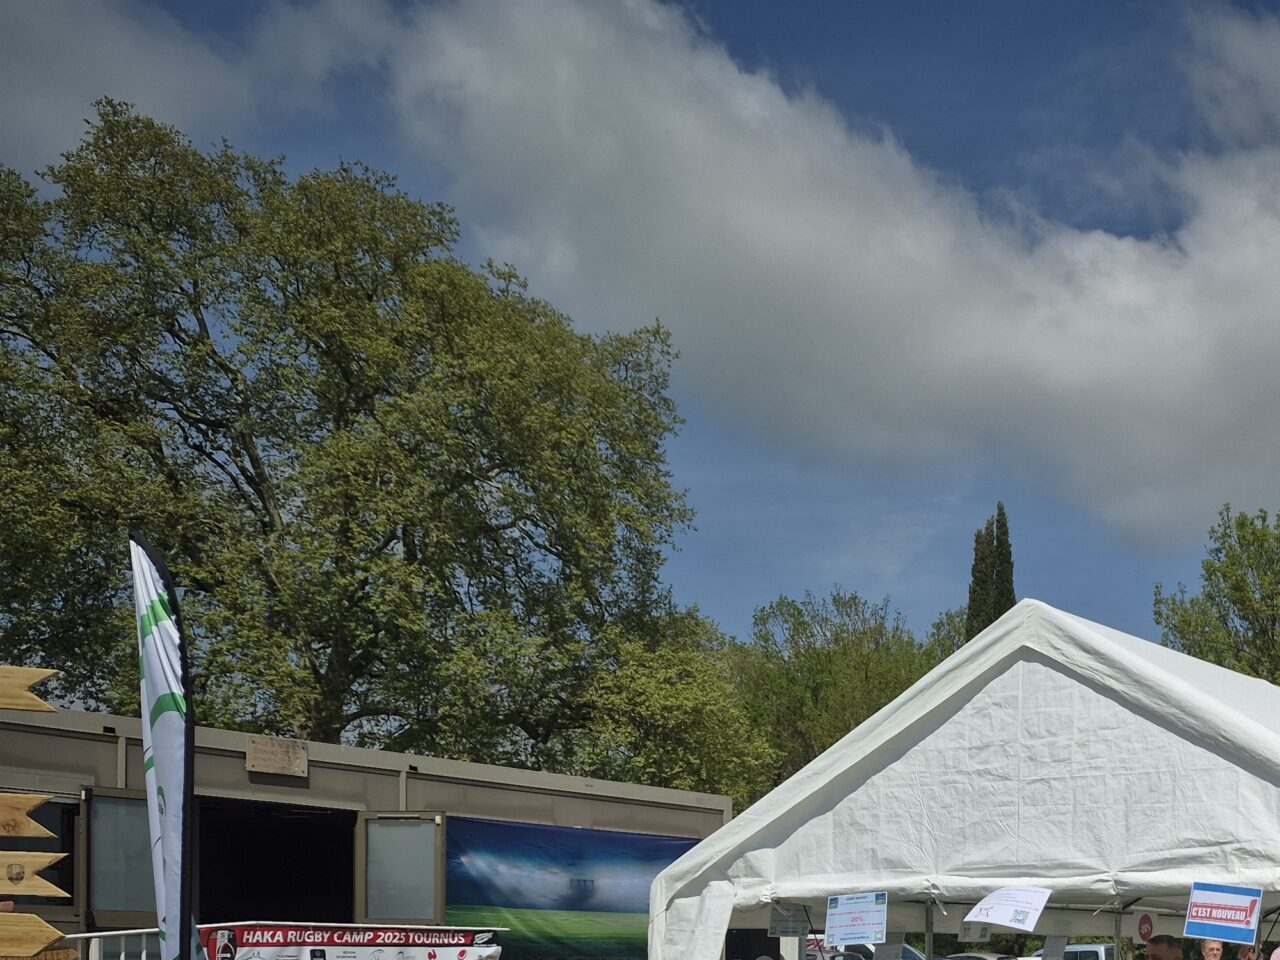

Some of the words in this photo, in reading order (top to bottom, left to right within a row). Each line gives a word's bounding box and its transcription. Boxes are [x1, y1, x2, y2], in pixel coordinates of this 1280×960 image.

[1192, 906, 1211, 917] C'EST
[1212, 909, 1246, 920] NOUVEAU
[242, 930, 284, 943] HAKA
[287, 930, 331, 943] RUGBY
[333, 931, 374, 943] CAMP
[376, 931, 406, 943] 2025
[408, 932, 465, 944] TOURNUS
